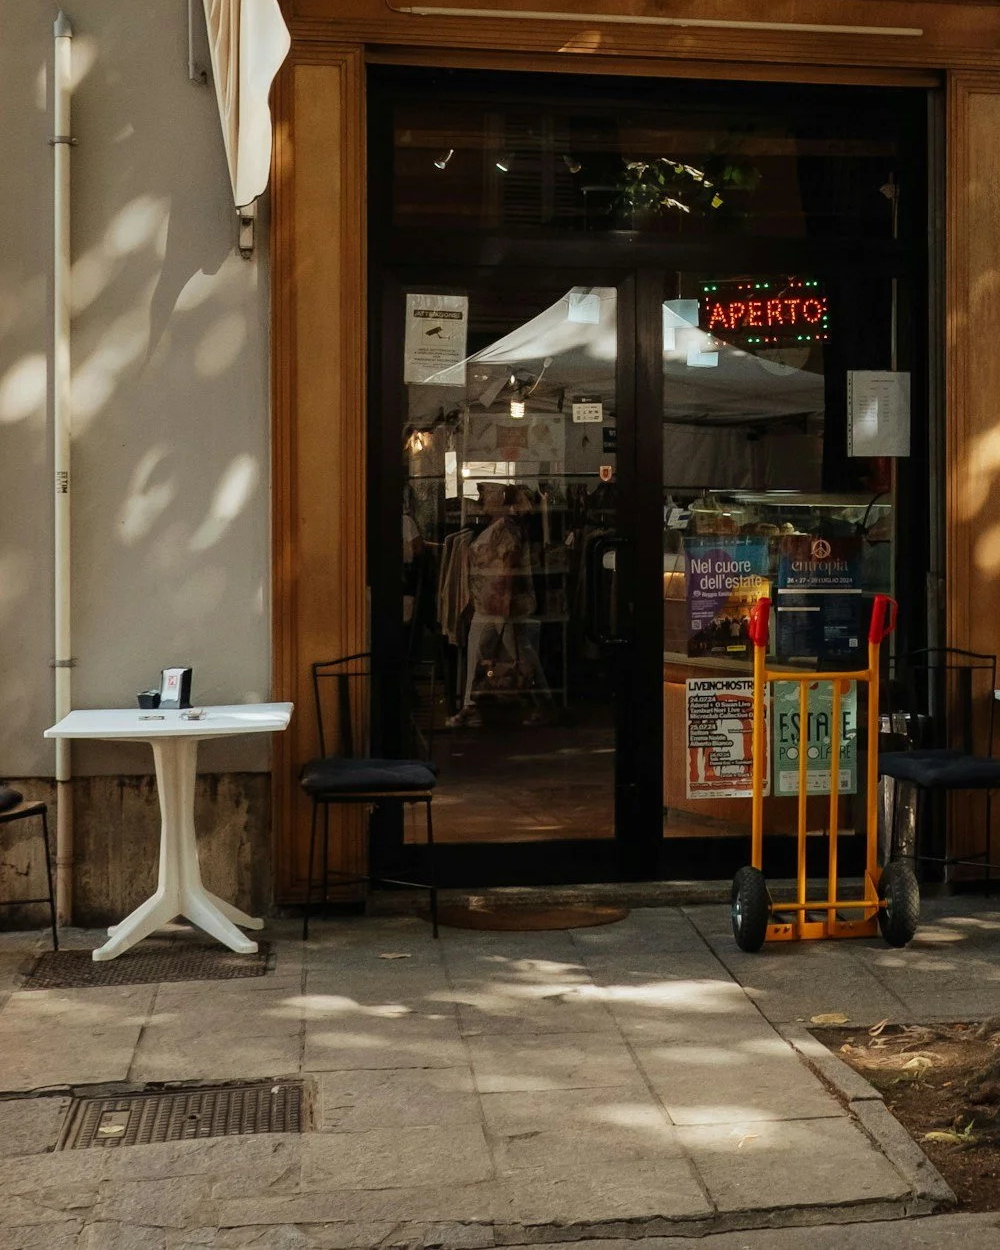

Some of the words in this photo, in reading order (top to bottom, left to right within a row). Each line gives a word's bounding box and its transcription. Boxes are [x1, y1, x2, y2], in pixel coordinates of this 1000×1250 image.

[709, 299, 822, 329] APERTO
[691, 558, 711, 574] Nel
[715, 560, 751, 573] cuore
[791, 558, 848, 576] entropia
[700, 574, 762, 590] dell'estate
[779, 711, 851, 742] ESTAE
[779, 744, 851, 761] POOLARE
